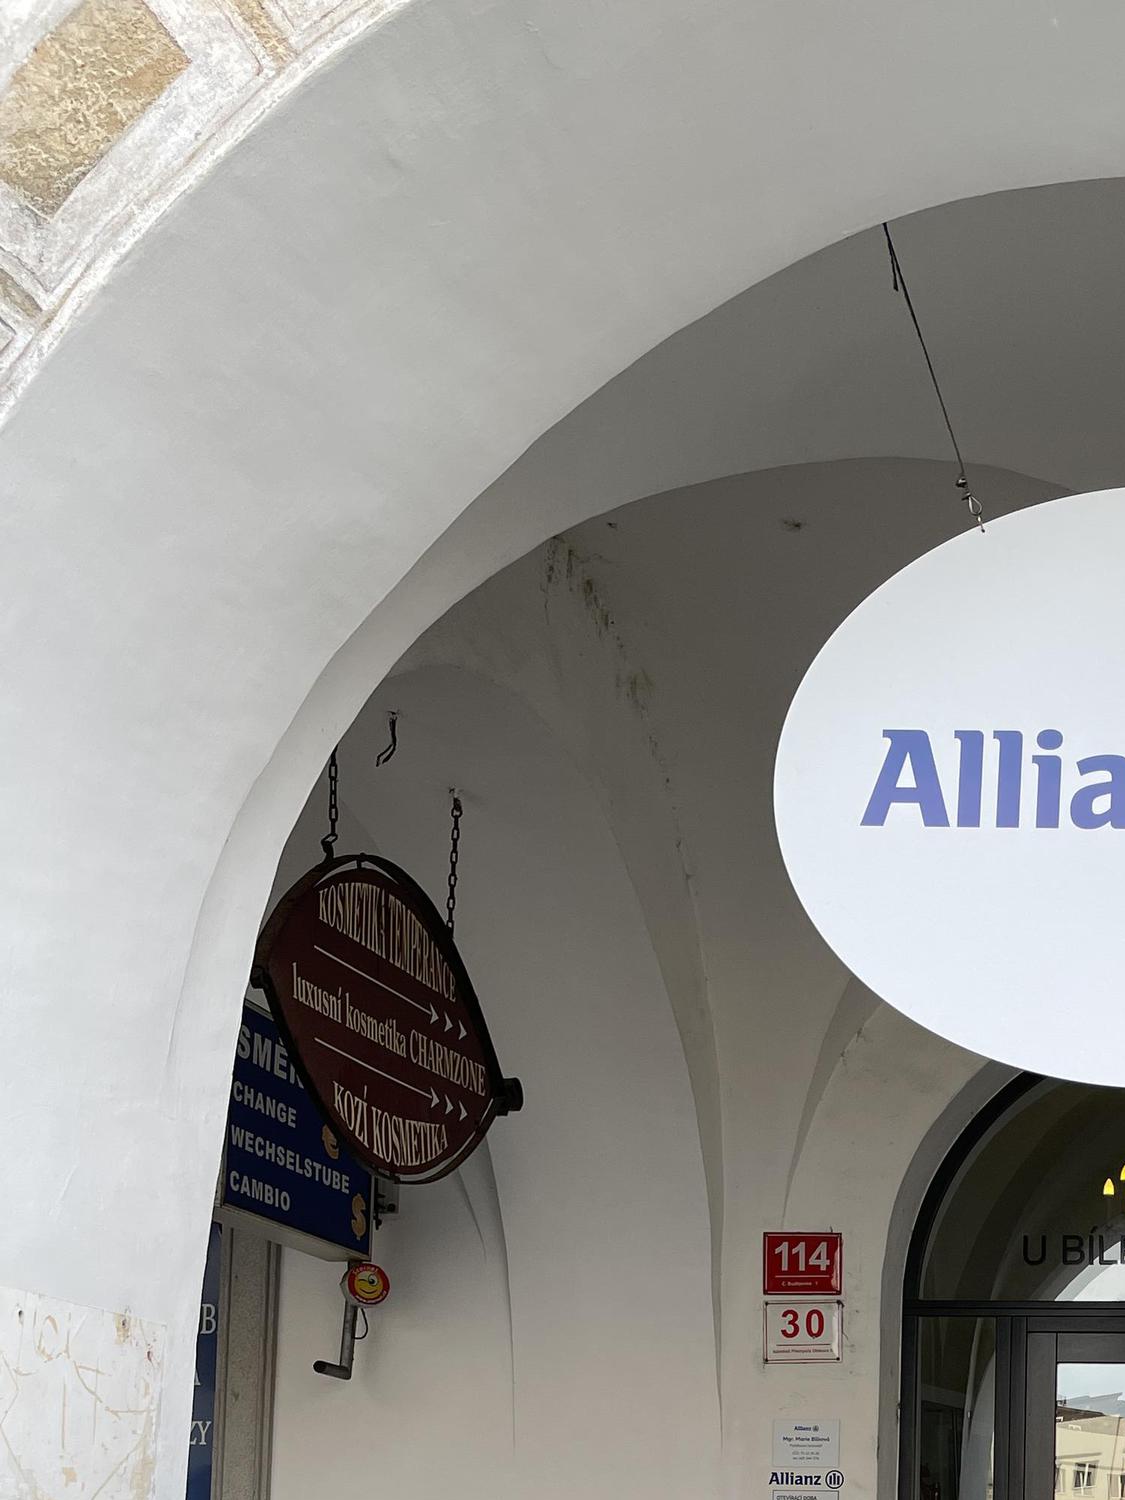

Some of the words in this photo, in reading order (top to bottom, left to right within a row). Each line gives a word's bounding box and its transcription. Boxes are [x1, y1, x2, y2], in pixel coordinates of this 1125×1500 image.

[319, 882, 386, 959] KOSMETIKA
[388, 893, 456, 1003] TEMPERANCE
[292, 962, 342, 1024] luxusní
[345, 992, 407, 1057] kosmetika
[409, 1030, 486, 1097] CHARMZONE
[233, 1080, 297, 1129] CHANGE
[333, 1081, 369, 1148] KOZÍ
[371, 1106, 448, 1167] KOSMETIKA
[231, 1124, 350, 1194] WECHSELSTUBE
[229, 1170, 291, 1212] CAMBIO
[774, 1241, 831, 1272] 114
[1022, 1235, 1048, 1266] U
[780, 1309, 825, 1339] 30
[768, 1472, 822, 1486] Allianz
